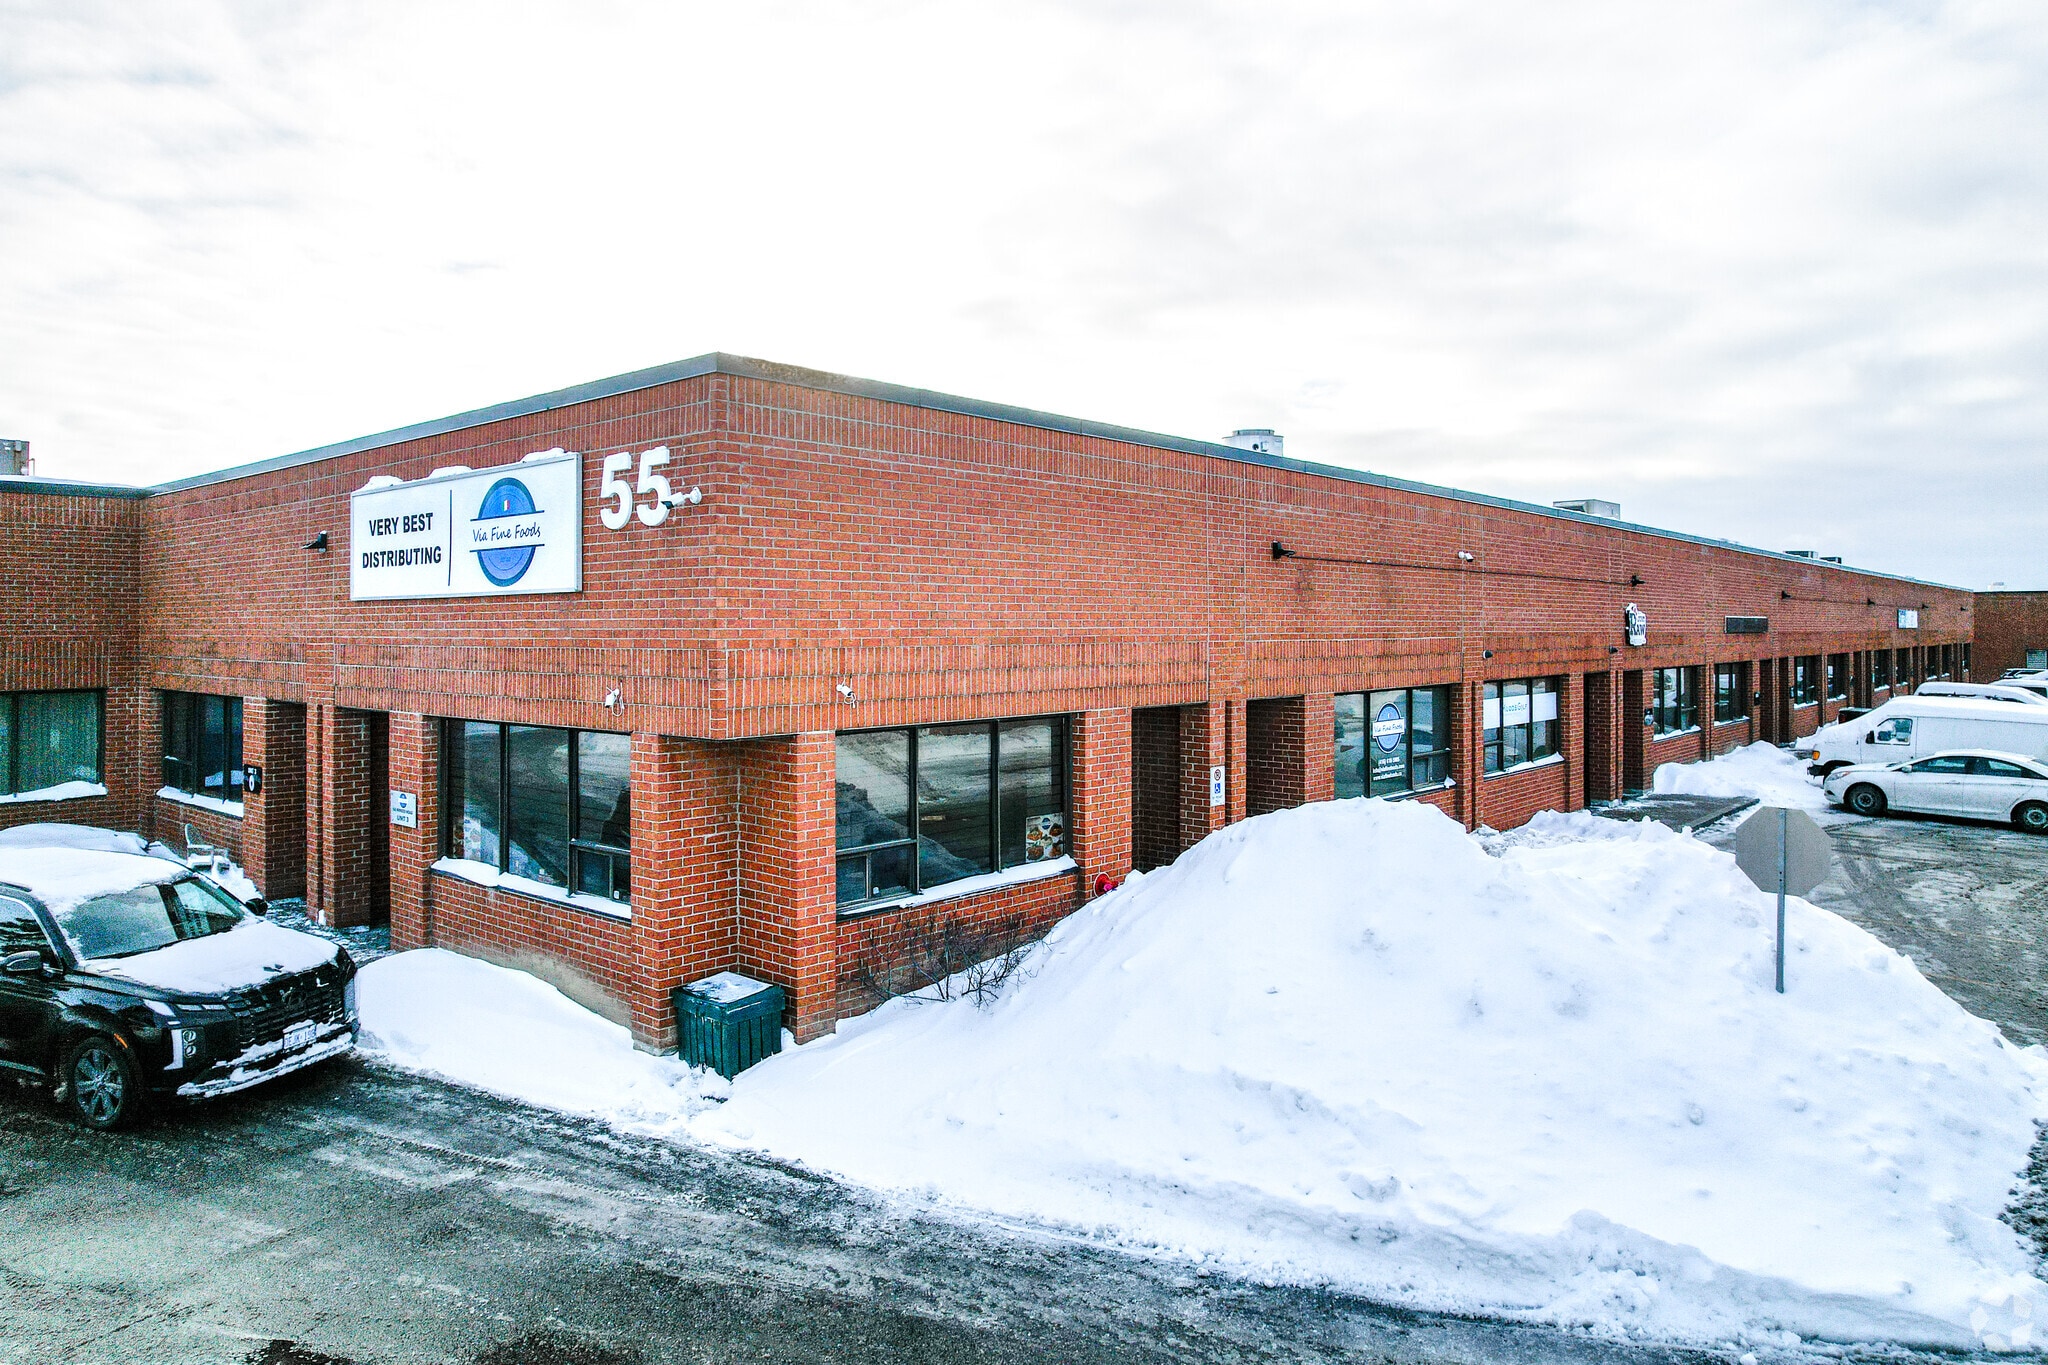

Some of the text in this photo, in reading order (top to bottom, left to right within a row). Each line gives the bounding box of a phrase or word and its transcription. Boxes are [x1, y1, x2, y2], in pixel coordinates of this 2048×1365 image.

[599, 445, 671, 530] 55
[368, 512, 434, 537] VERY BEST
[472, 521, 541, 542] Via Fine Foods
[362, 545, 442, 569] DISTRIBUTING
